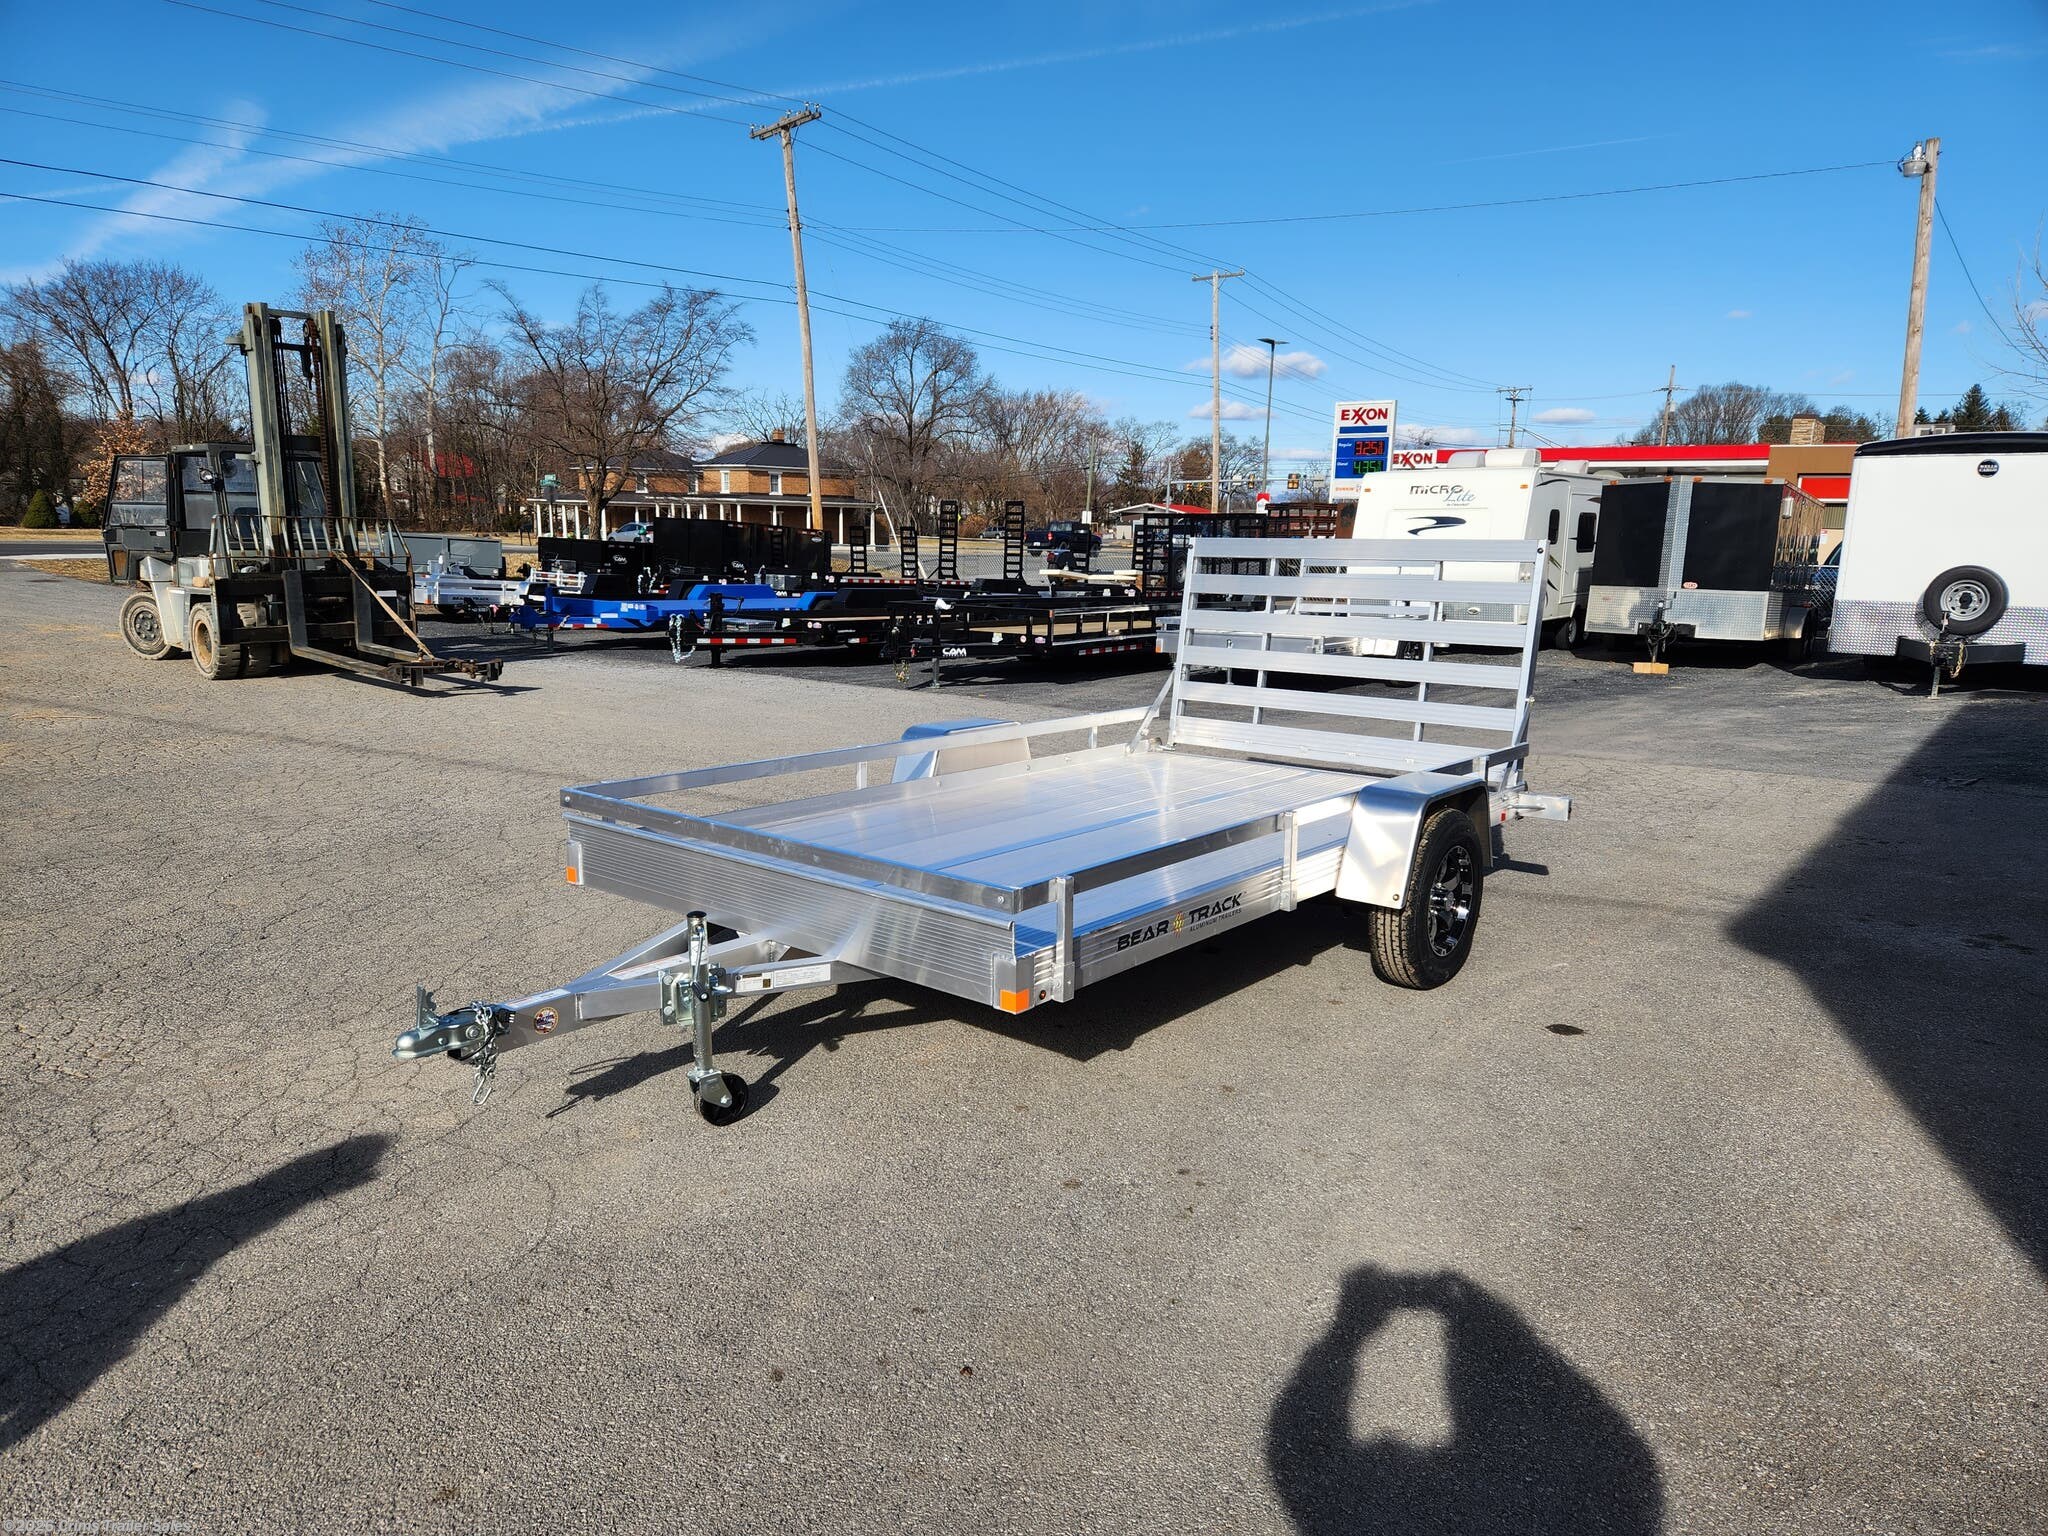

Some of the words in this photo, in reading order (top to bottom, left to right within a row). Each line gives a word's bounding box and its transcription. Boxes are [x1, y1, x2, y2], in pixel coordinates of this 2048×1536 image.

[1341, 407, 1388, 425] EXXON
[1393, 452, 1433, 469] EXXON
[942, 647, 967, 655] CAM
[1117, 920, 1170, 951] BEAR
[1188, 893, 1243, 924] TRACK
[1218, 908, 1242, 921] TRAILERS
